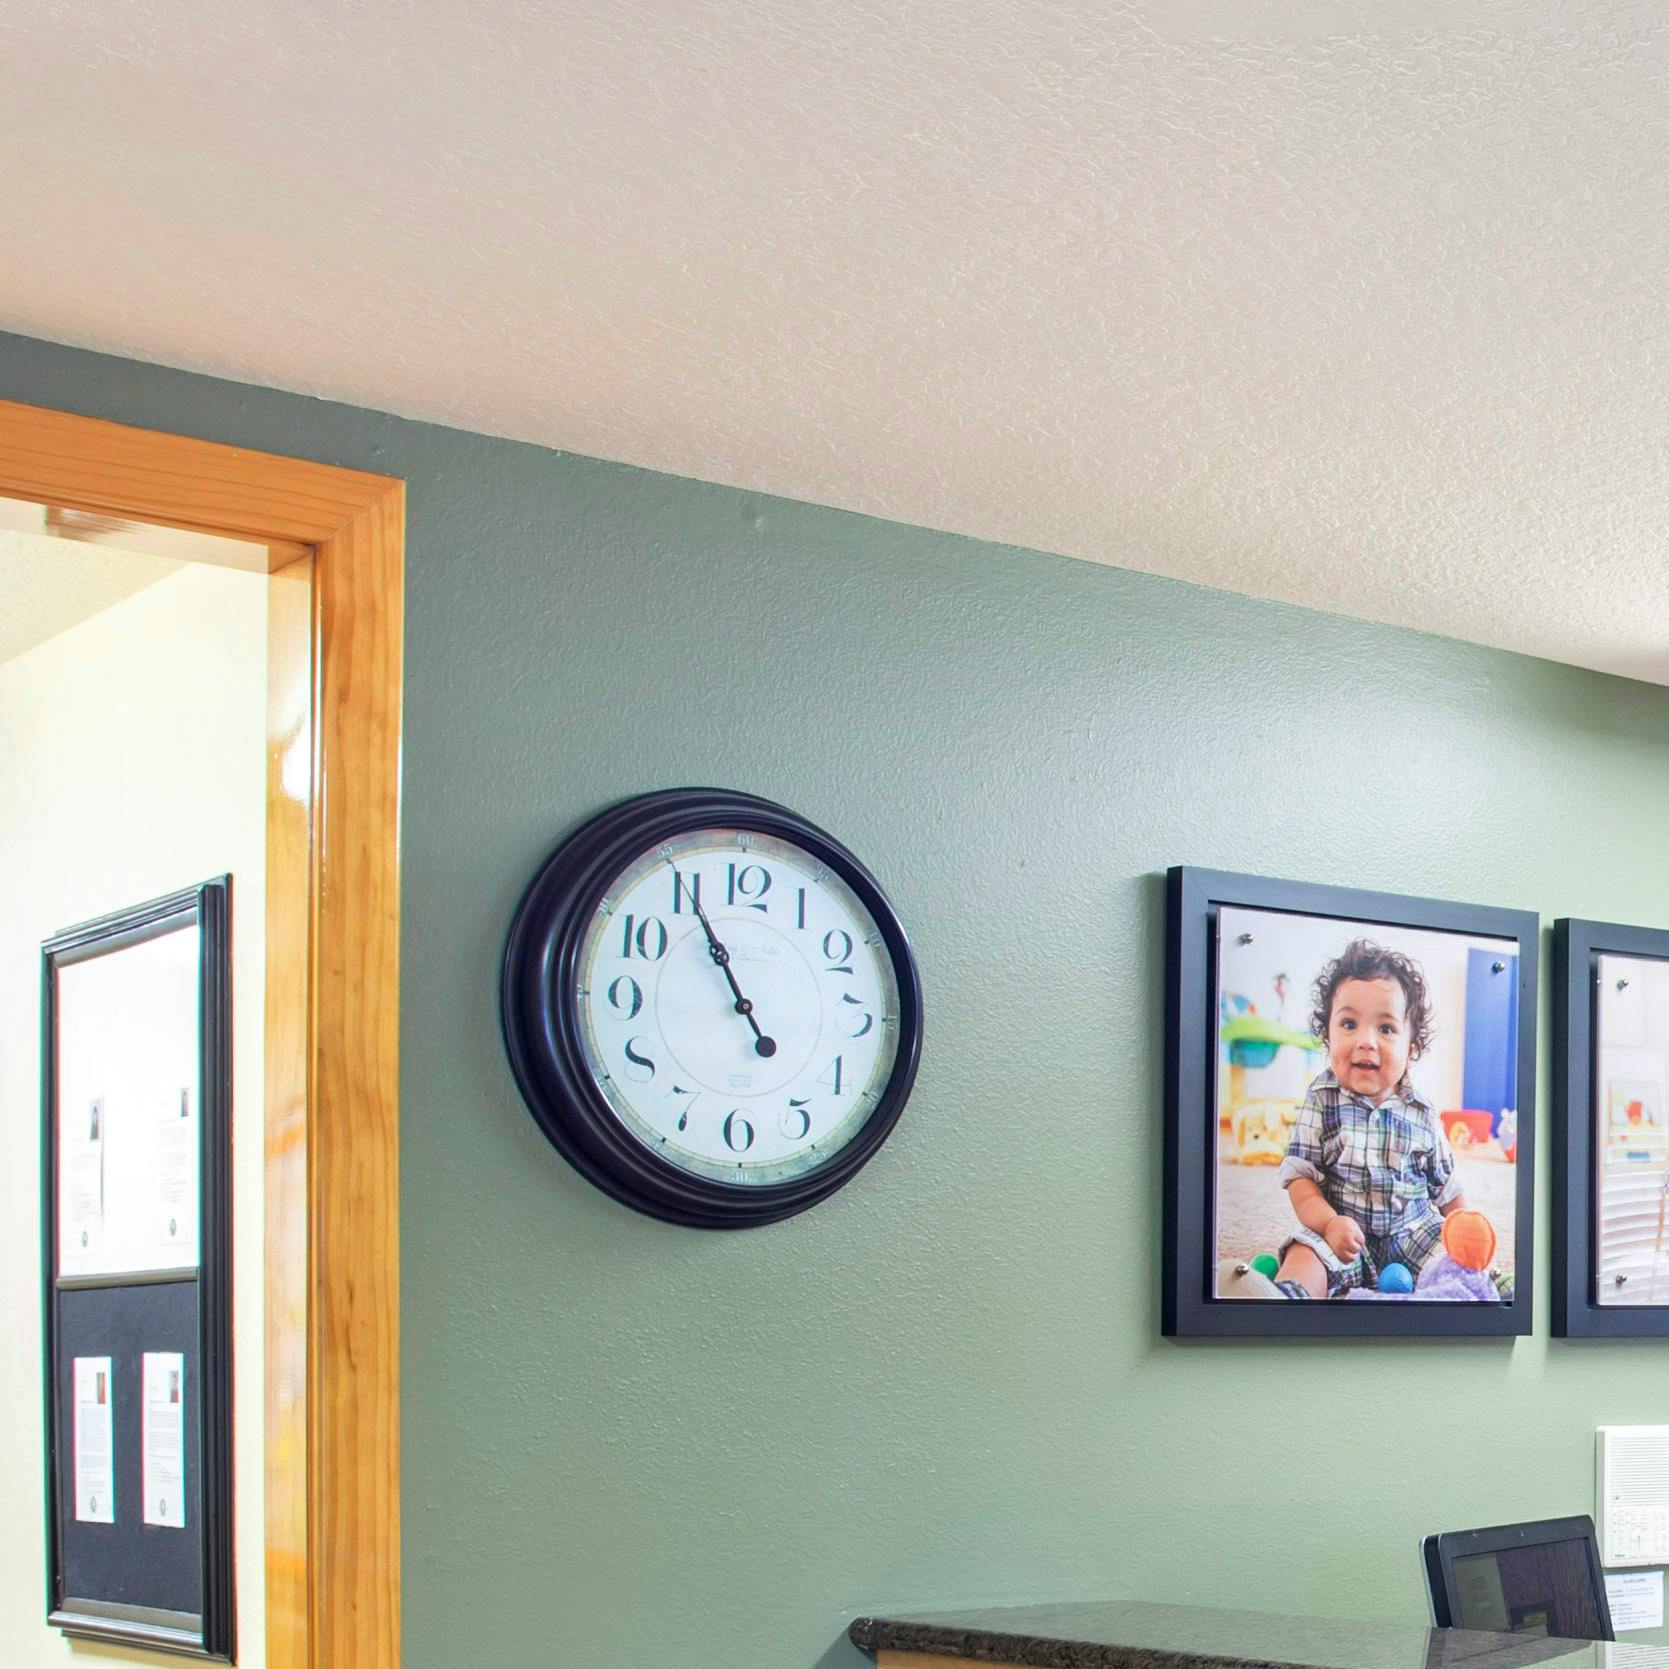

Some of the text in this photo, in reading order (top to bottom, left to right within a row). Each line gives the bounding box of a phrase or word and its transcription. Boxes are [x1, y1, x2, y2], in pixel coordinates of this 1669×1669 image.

[670, 870, 705, 915] 11
[723, 863, 773, 913] 12
[793, 887, 809, 930] 1
[617, 914, 668, 961] 10
[823, 930, 854, 974] 2
[607, 974, 643, 1020] 9
[835, 993, 873, 1039] 3
[624, 1035, 656, 1082] 8
[816, 1055, 852, 1096] 4
[666, 1085, 701, 1131] 7
[724, 1108, 755, 1153] 6
[778, 1099, 811, 1140] 5
